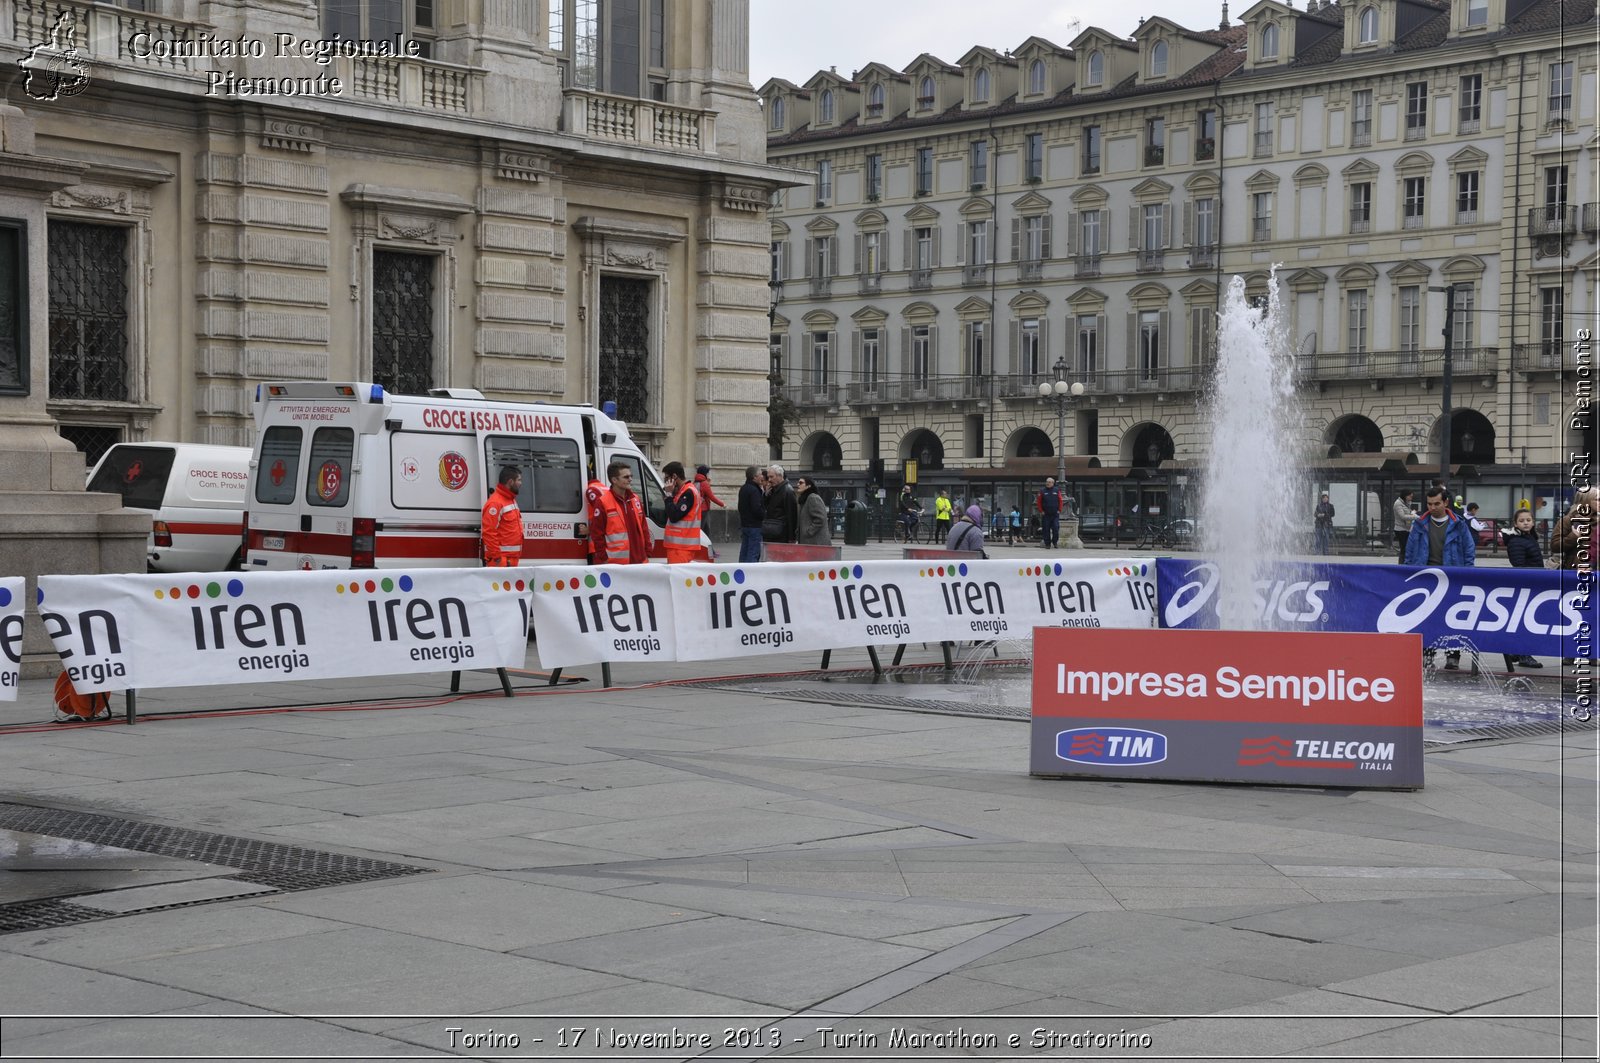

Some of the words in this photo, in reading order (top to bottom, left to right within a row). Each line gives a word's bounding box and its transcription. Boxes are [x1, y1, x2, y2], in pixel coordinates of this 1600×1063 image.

[313, 406, 351, 414] EMERGENZA
[423, 409, 469, 430] CROCE
[504, 413, 562, 434] ITALIANA
[190, 469, 218, 478] CROCE
[221, 471, 249, 480] ROSSA
[199, 480, 219, 488] Com.
[527, 522, 572, 530] EMERGENZA
[832, 583, 907, 620] iren
[941, 581, 1005, 615] iren
[1036, 580, 1096, 613] iren
[368, 597, 471, 642] iren
[573, 594, 658, 633] iren
[710, 588, 791, 629] iren
[192, 604, 306, 651] iren
[741, 627, 793, 647] energia
[866, 619, 910, 638] energia
[970, 617, 1008, 634] energia
[410, 641, 475, 664] energia
[613, 635, 660, 655] energia
[238, 650, 310, 673] energia
[1057, 663, 1207, 702] Impresa
[1215, 666, 1395, 707] Semplice
[1106, 735, 1154, 758] TIM
[1294, 739, 1395, 761] TELECOM
[1360, 762, 1393, 772] ITALIA
